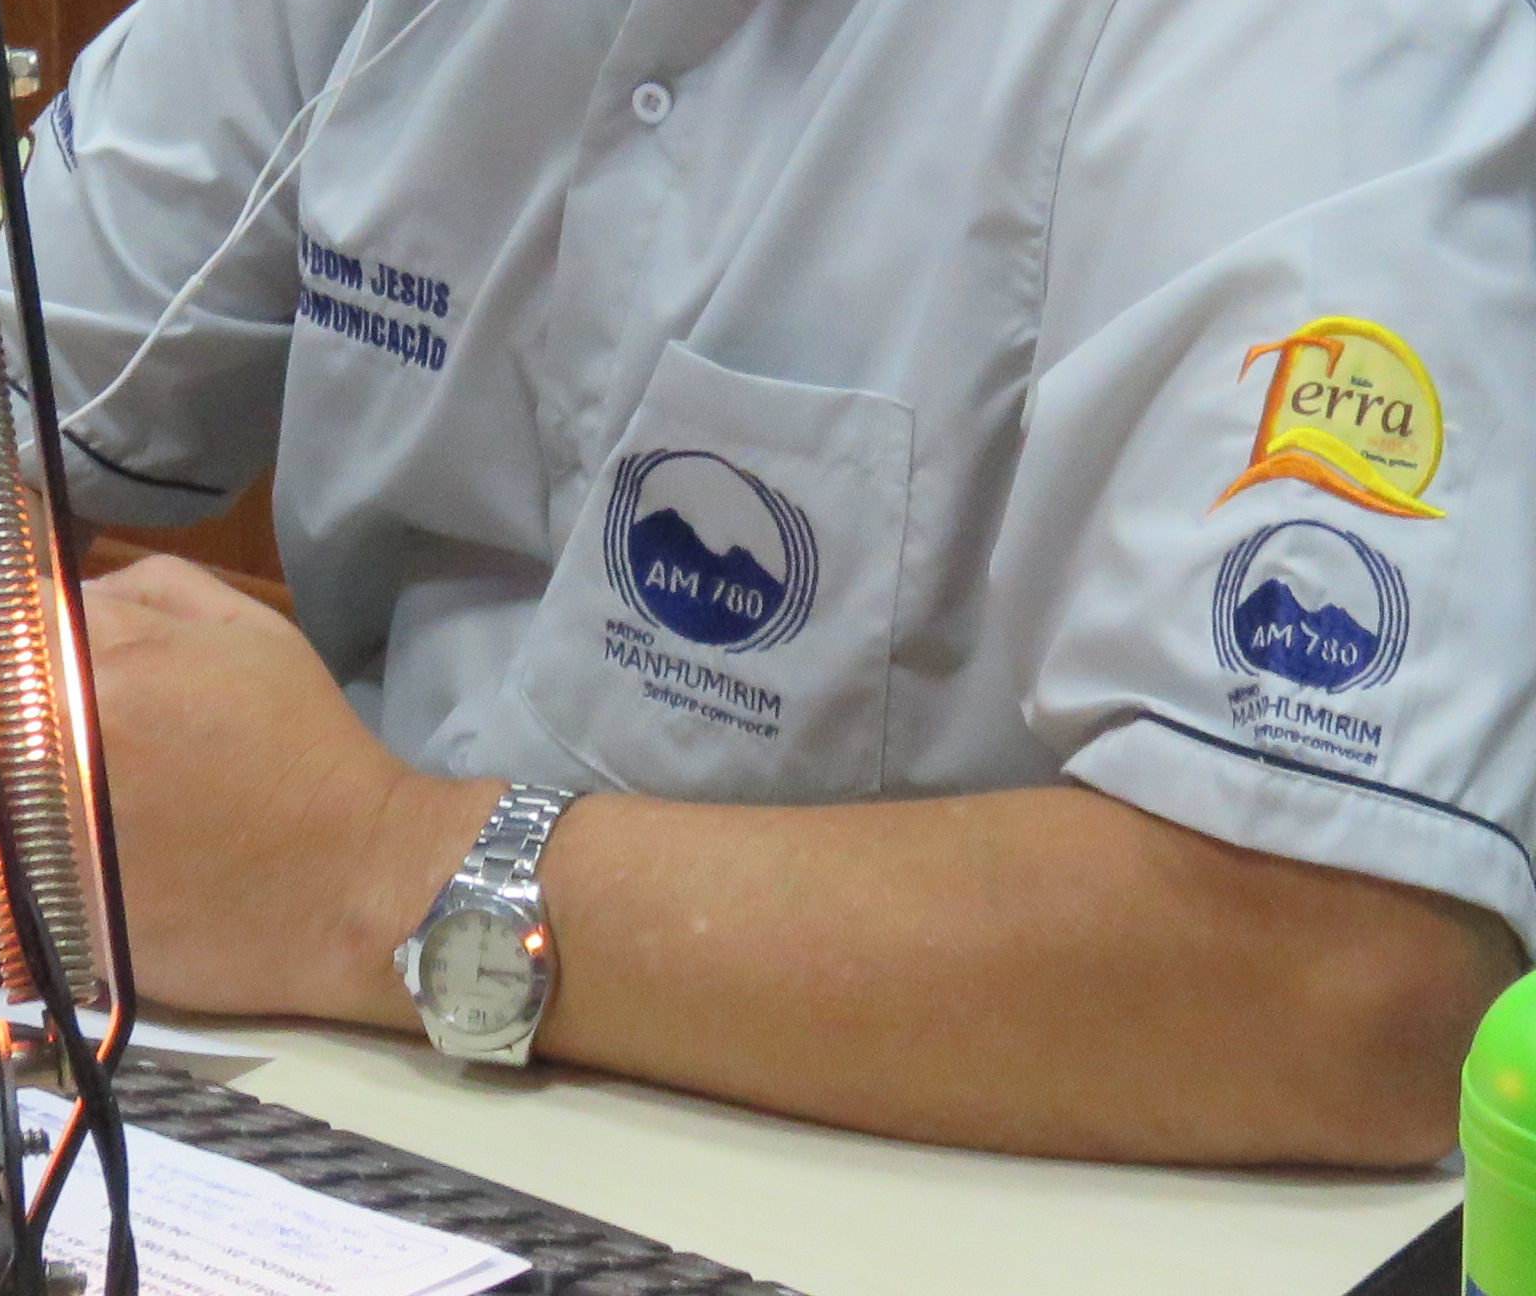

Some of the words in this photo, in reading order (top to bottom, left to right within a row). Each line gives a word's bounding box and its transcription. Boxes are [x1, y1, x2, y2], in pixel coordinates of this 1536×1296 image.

[370, 263, 450, 318] JESUS
[299, 287, 448, 371] OMUNICAÇÃO
[1237, 336, 1414, 468] Terra
[645, 560, 700, 599] AM
[1250, 622, 1294, 649] AM
[1300, 620, 1358, 667] 780
[604, 637, 781, 720] MANHUMIRIM
[1231, 695, 1382, 748] MANHUMIRIM
